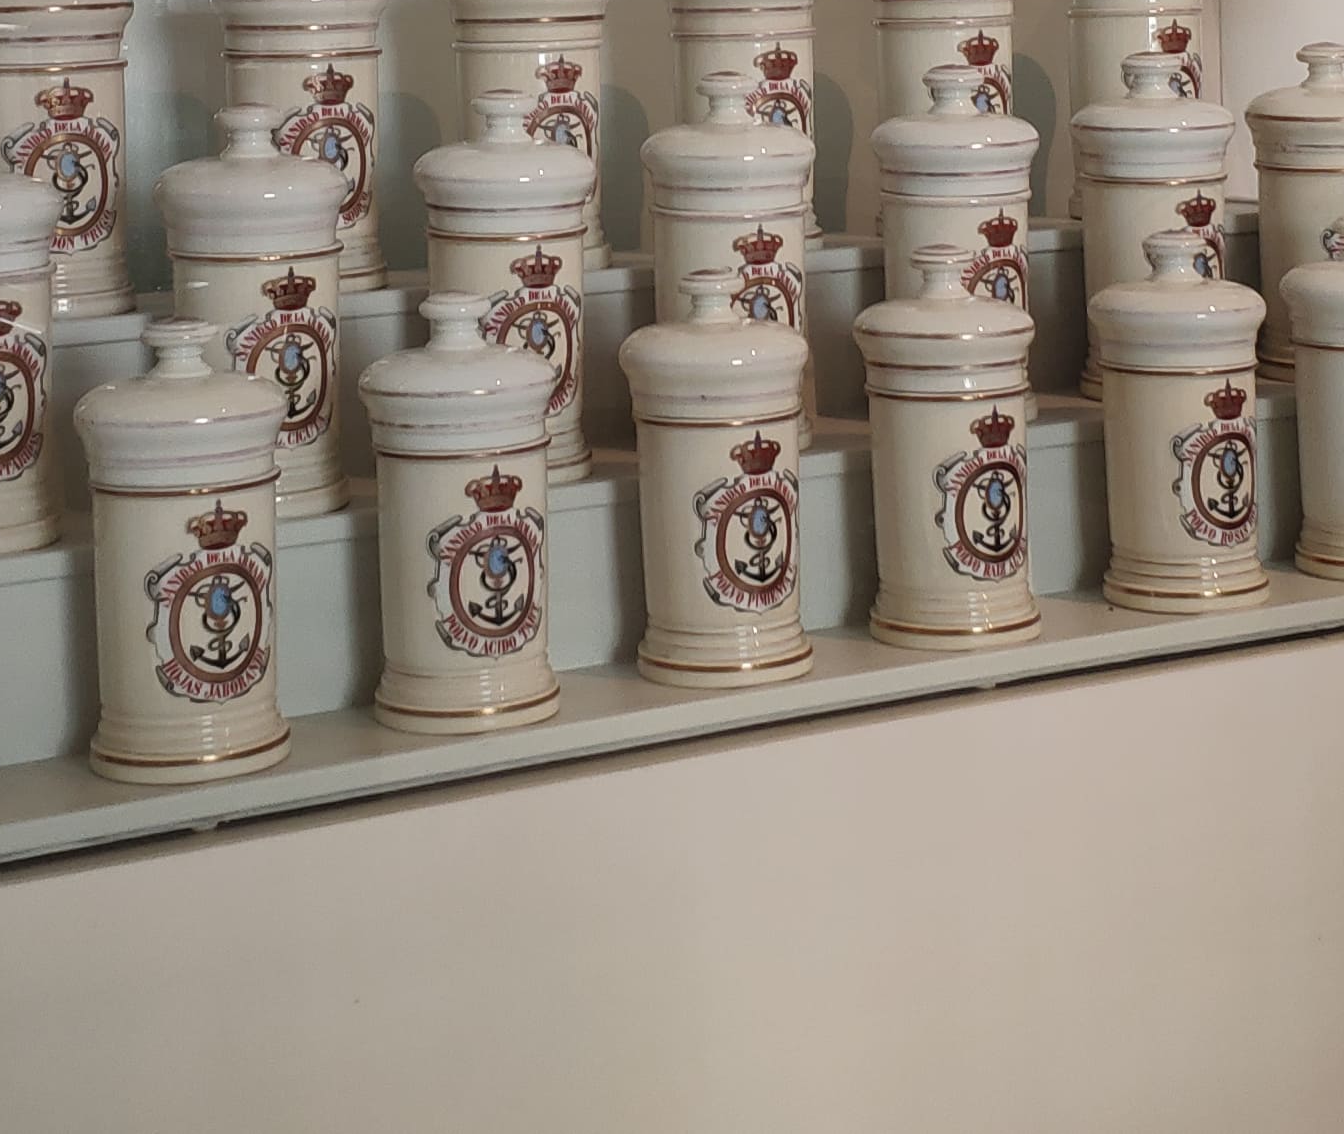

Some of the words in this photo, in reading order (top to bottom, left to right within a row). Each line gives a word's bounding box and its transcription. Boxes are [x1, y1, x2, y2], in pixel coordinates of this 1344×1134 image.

[13, 125, 53, 168] SANIDAD
[55, 122, 68, 132] DE
[69, 121, 81, 131] LA
[83, 125, 113, 163] ARMADA
[279, 111, 320, 152] SANIDAD
[322, 107, 333, 116] DE
[334, 106, 345, 116] LA
[346, 110, 370, 147] ARMADA
[484, 296, 526, 336] SANIDAD
[528, 290, 539, 300] DE
[541, 290, 552, 299] LA
[235, 318, 278, 361] SANIDAD
[280, 313, 293, 324] DE
[294, 313, 305, 323] LA
[10, 342, 40, 383] ARMADA
[1220, 422, 1231, 433] DE
[1231, 422, 1240, 432] LA
[945, 454, 984, 498] SANIDAD
[986, 449, 998, 461] DE
[997, 449, 1008, 460] LA
[707, 482, 747, 526] SANIDAD
[749, 476, 761, 488] DE
[761, 476, 772, 487] LA
[440, 521, 483, 567] SANIDAD
[486, 515, 498, 526] DE
[499, 514, 512, 526] LA
[514, 517, 540, 559] ARMADA
[157, 560, 204, 608] SANIDAD
[206, 553, 221, 564] DE
[222, 550, 235, 563] LA
[238, 554, 267, 595] ARMADA
[709, 569, 745, 604] POLVO
[443, 612, 479, 650] POLVO
[481, 635, 518, 655] ACIDO
[162, 657, 203, 696] HOJAS
